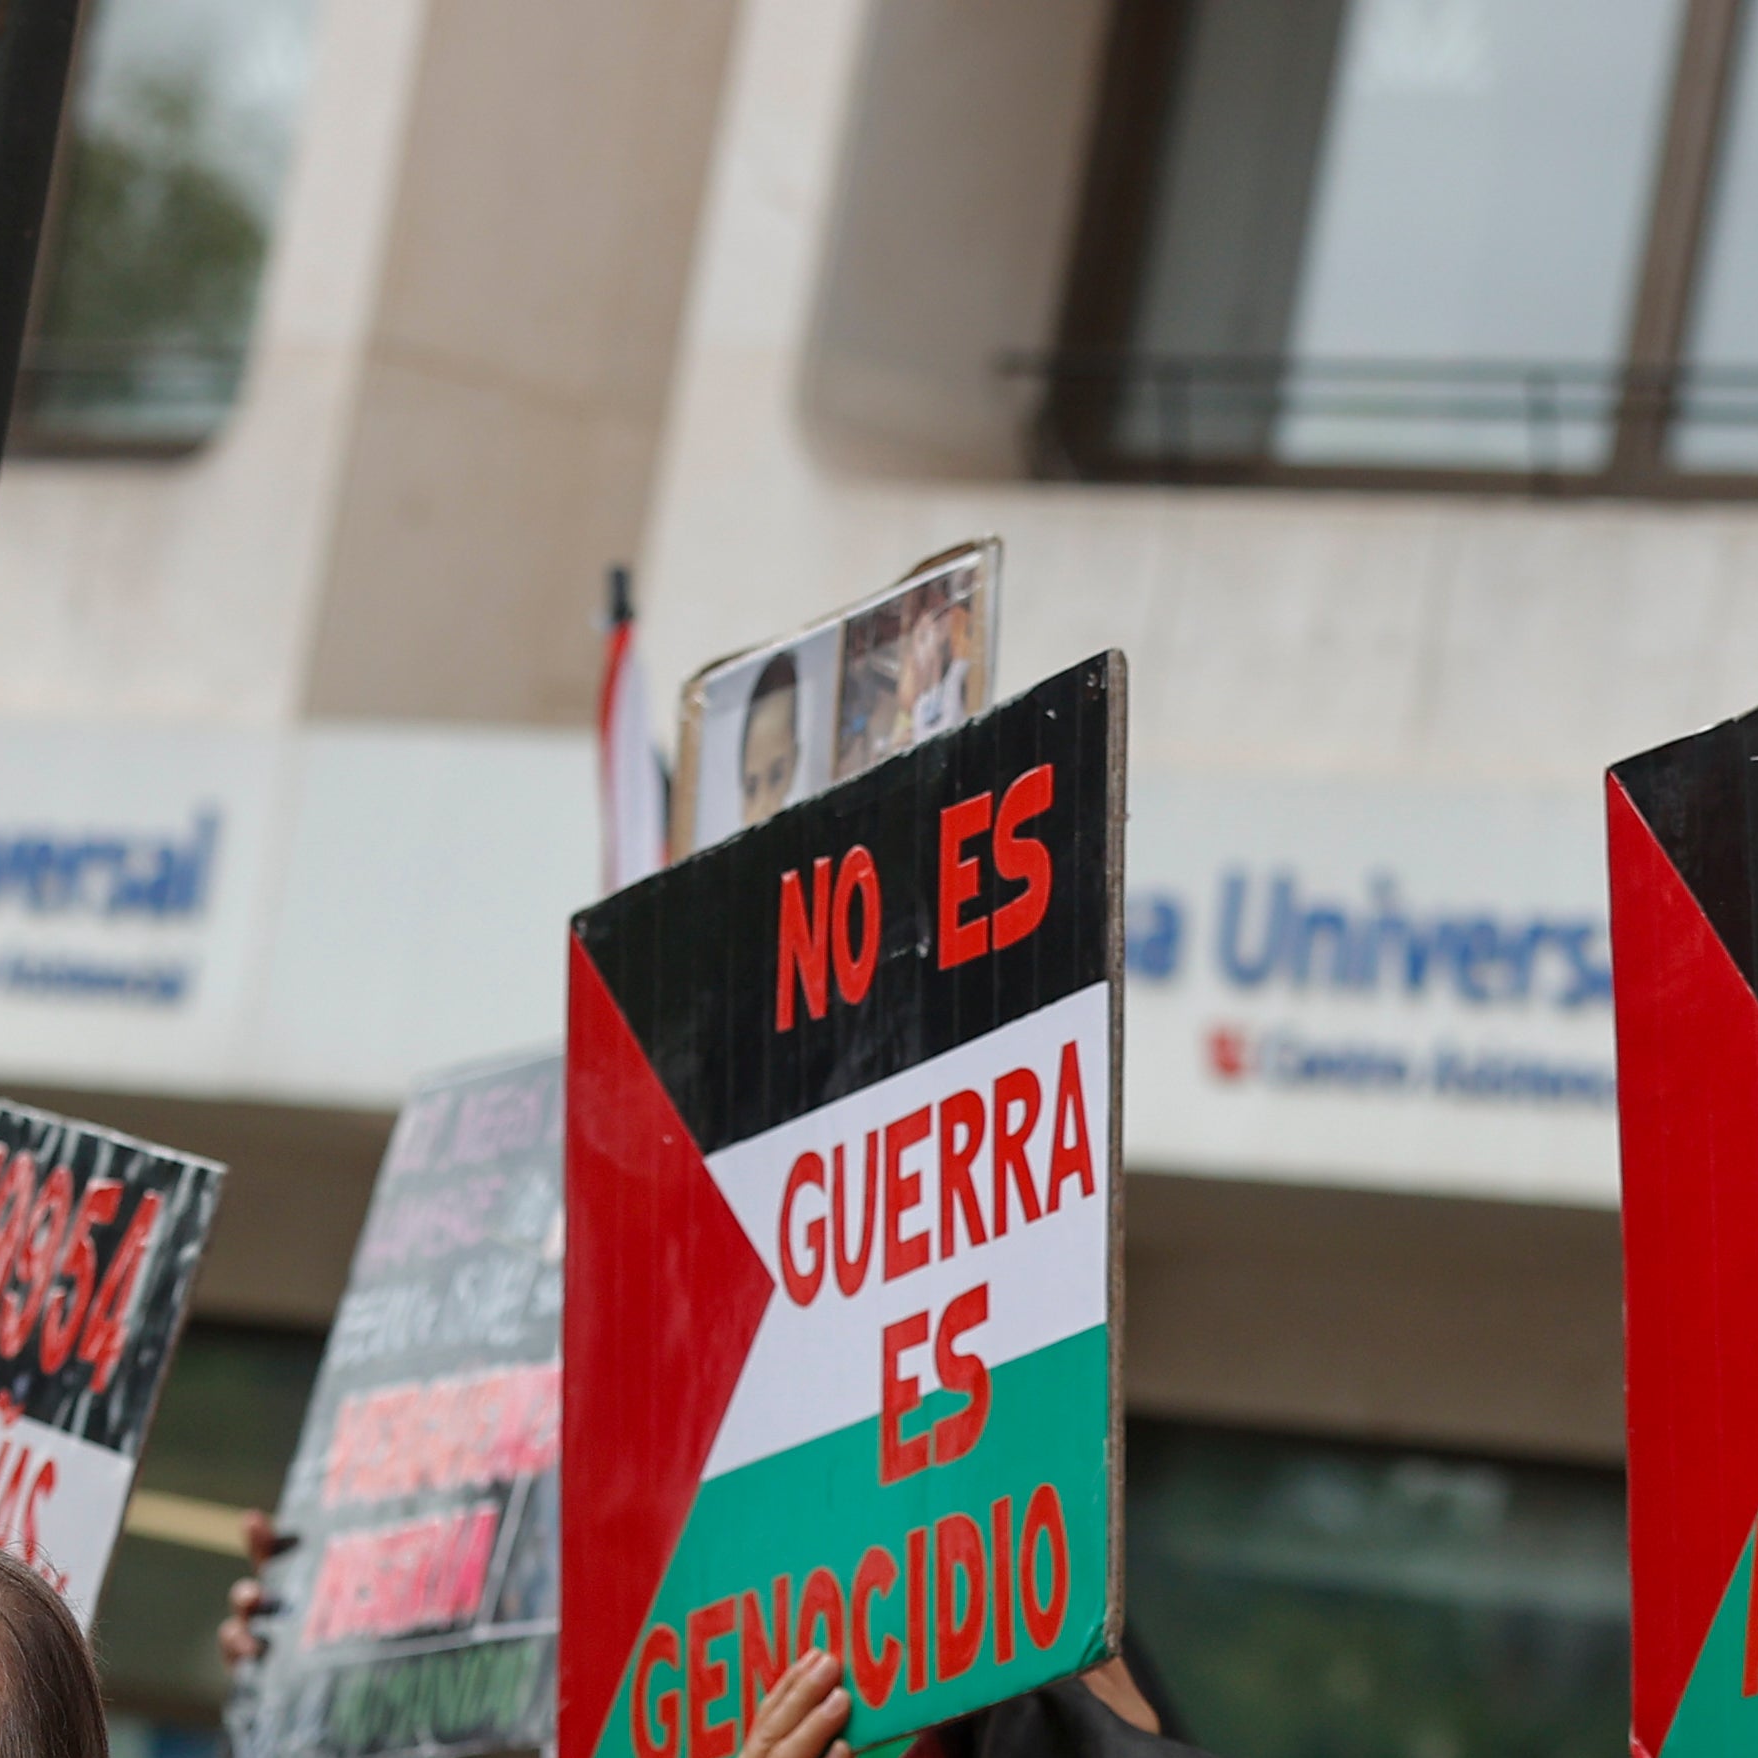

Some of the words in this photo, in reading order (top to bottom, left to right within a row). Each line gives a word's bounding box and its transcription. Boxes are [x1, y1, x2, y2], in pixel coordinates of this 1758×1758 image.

[775, 845, 881, 1032] NO
[937, 763, 1054, 971] ES
[778, 1040, 1095, 1310] GUERRA
[879, 1283, 990, 1487] ES
